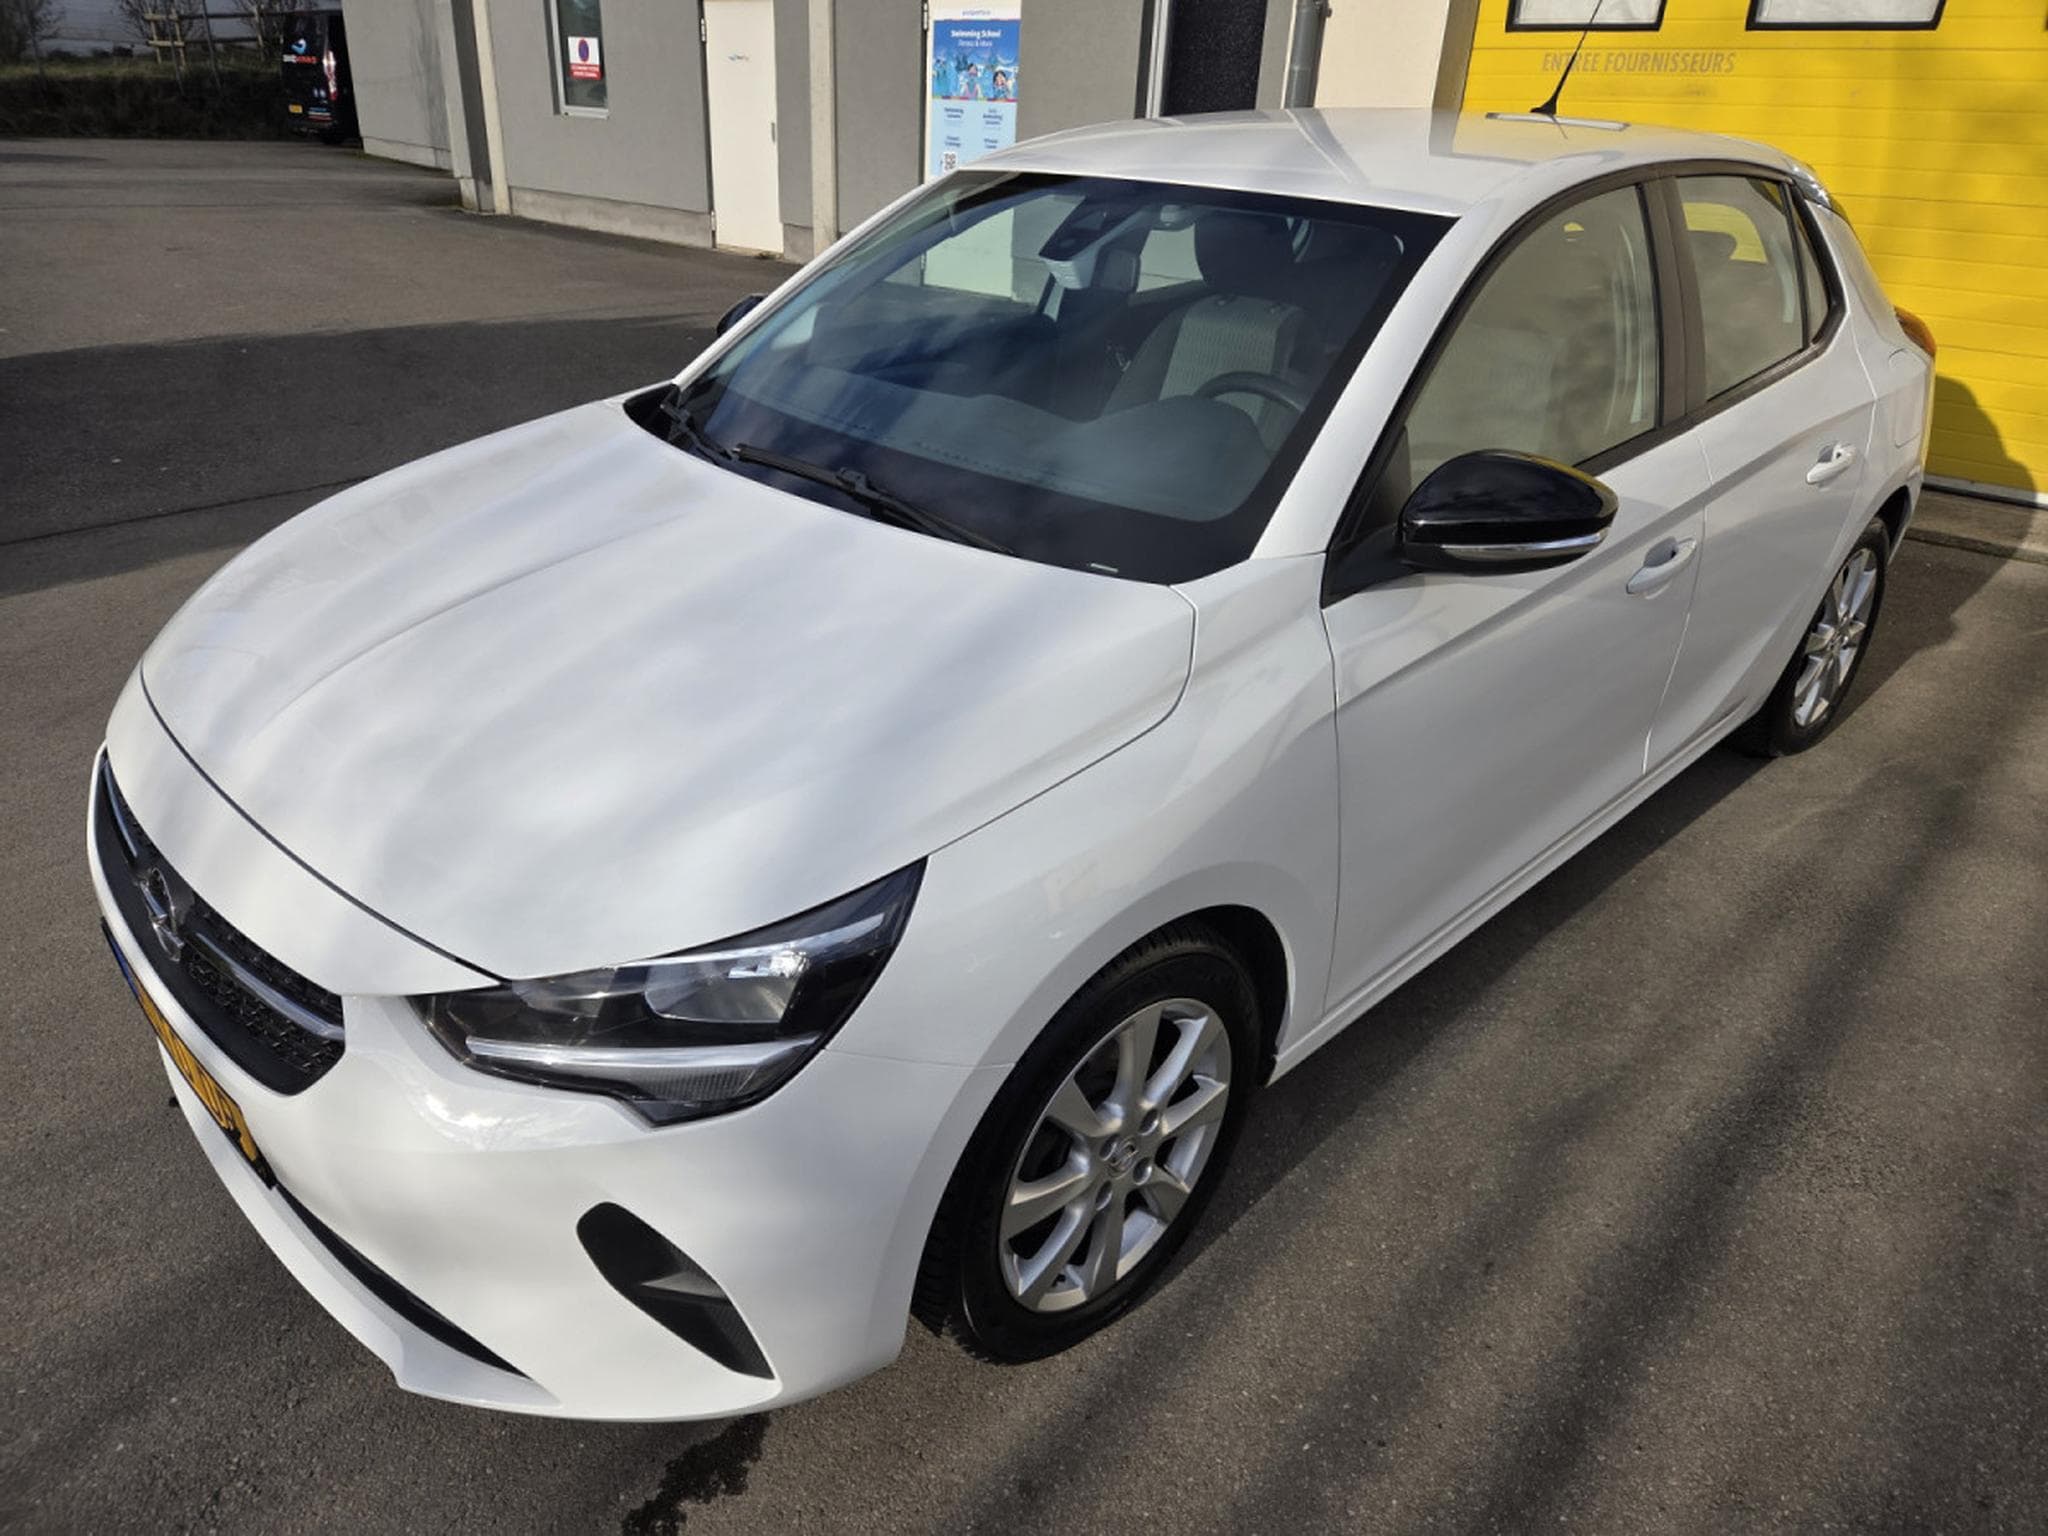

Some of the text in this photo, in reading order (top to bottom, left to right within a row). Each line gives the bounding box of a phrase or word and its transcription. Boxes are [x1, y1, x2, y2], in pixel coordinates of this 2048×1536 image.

[951, 30, 1001, 39] Swimming School
[1603, 52, 1735, 74] FOURNISSEURS
